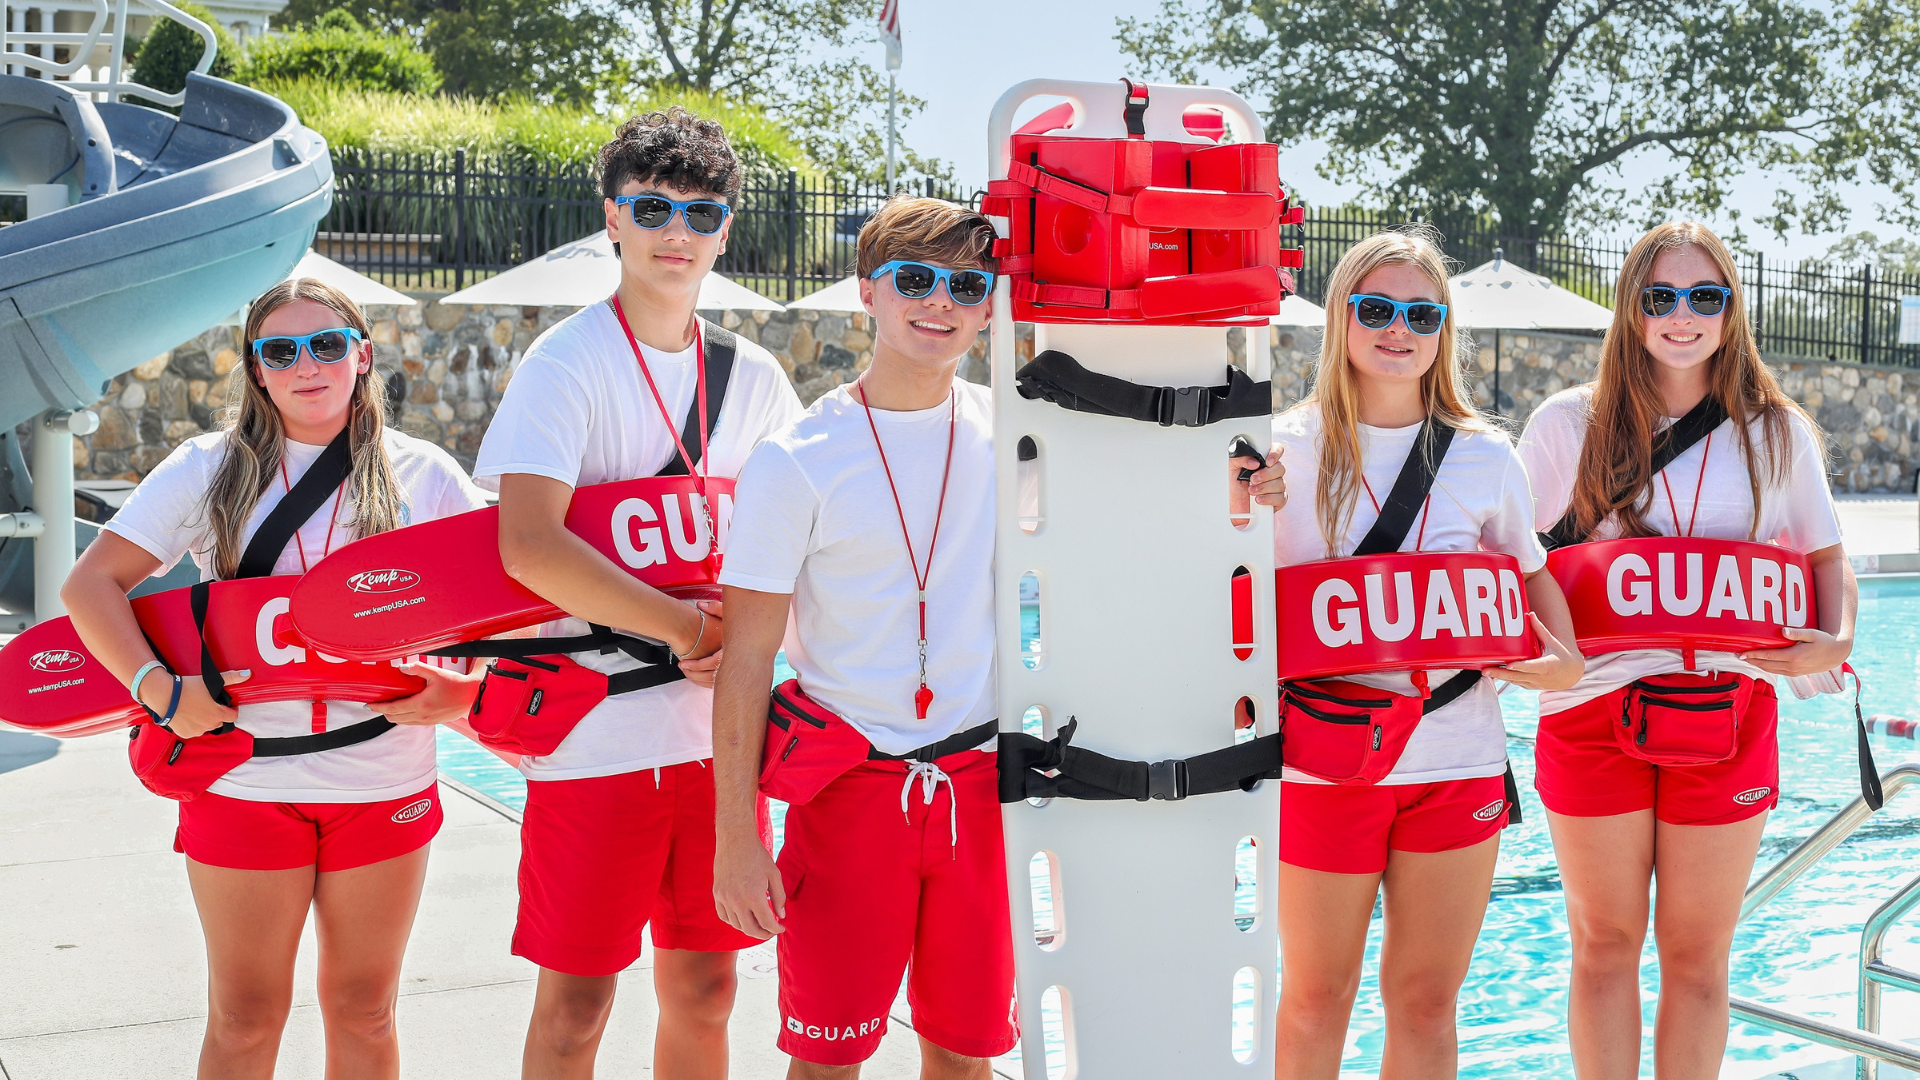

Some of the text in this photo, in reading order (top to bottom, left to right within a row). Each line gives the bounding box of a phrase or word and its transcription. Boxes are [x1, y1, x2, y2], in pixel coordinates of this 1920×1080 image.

[350, 569, 399, 592] Kemp
[1607, 552, 1808, 628] GUARD
[353, 596, 426, 618] www.kempUSA.com
[1311, 568, 1525, 648] GUARD
[32, 650, 70, 670] Kemp
[28, 677, 85, 694] www.kempUSA.com
[1743, 790, 1766, 801] GUARD
[403, 802, 426, 818] GUARD
[806, 1017, 881, 1041] GUARD
